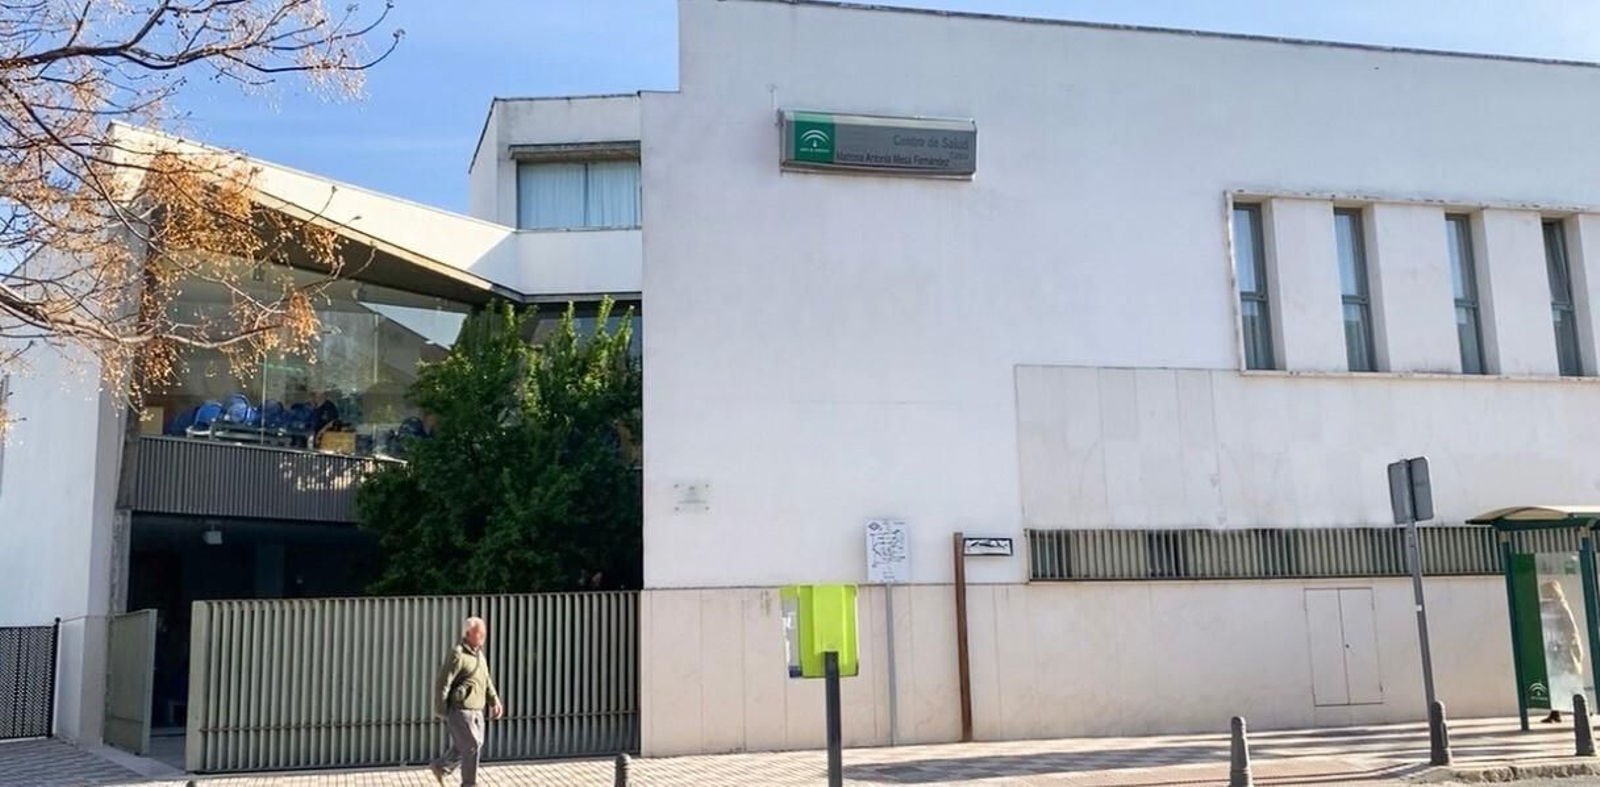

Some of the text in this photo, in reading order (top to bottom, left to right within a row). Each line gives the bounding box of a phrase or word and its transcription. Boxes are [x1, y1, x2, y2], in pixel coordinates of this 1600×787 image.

[893, 134, 969, 150] Centro de Salud
